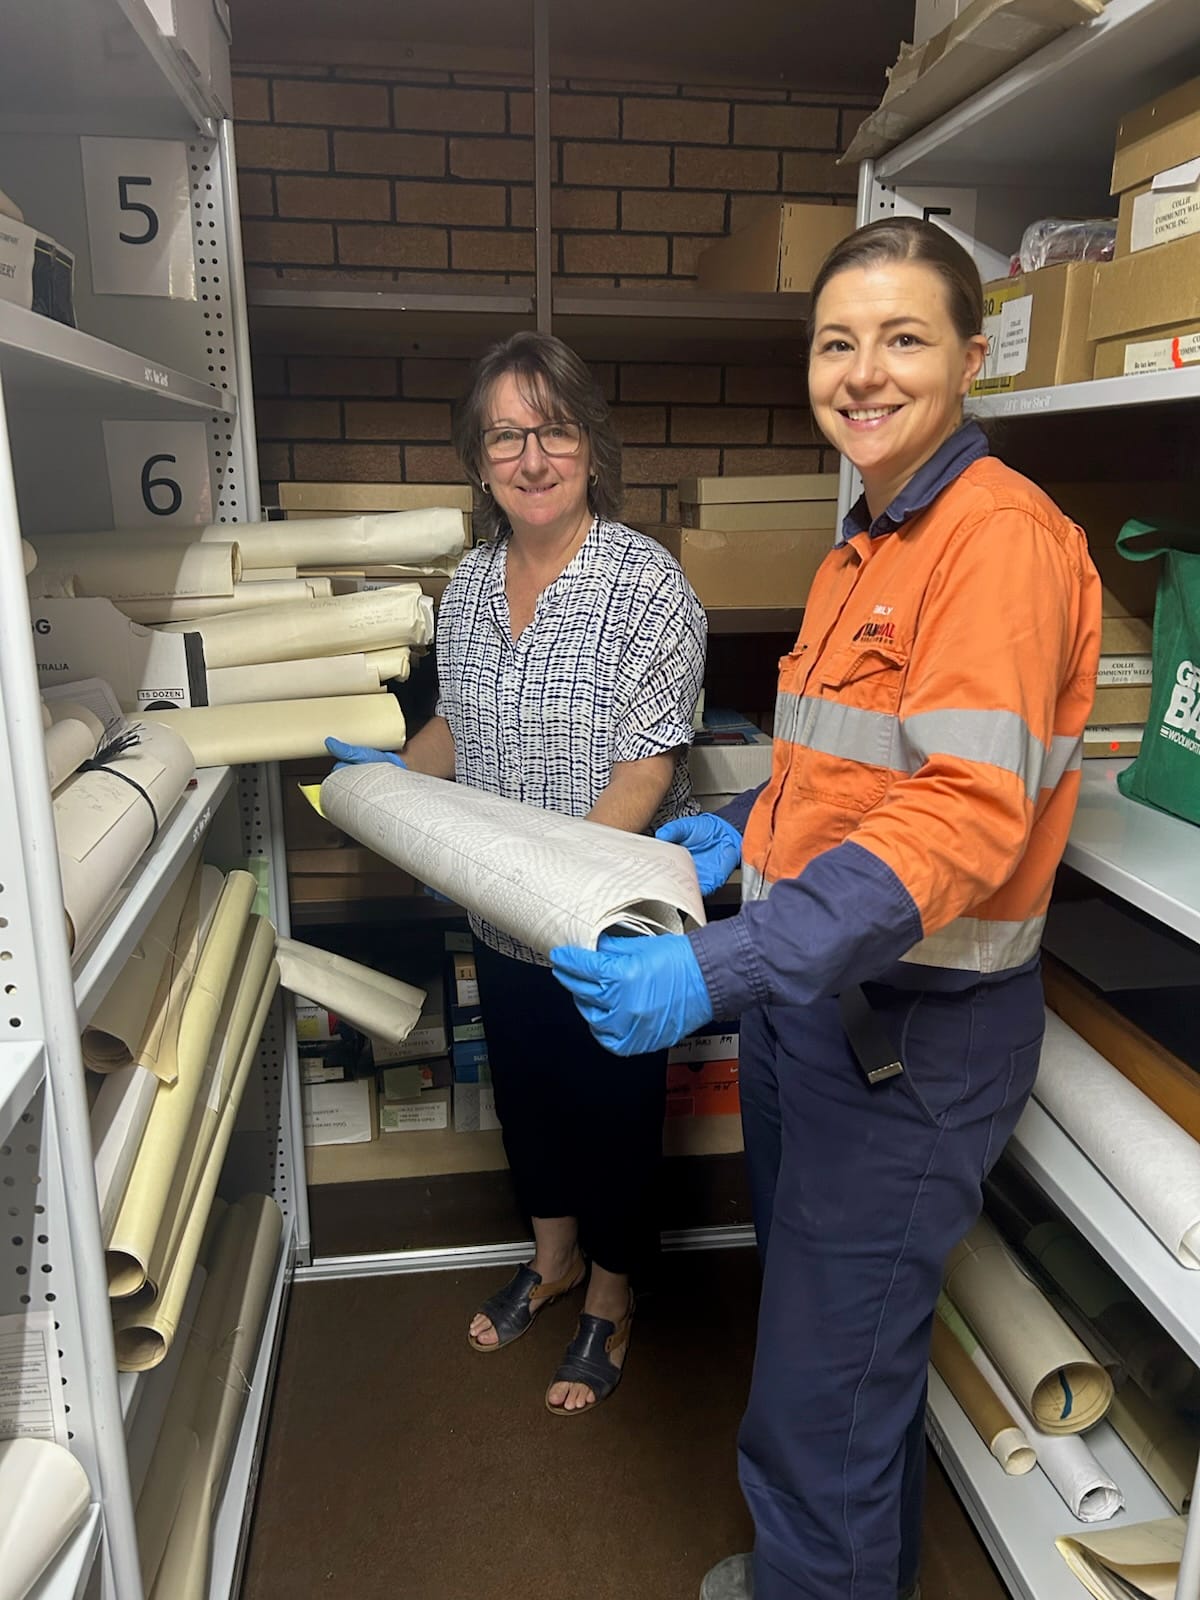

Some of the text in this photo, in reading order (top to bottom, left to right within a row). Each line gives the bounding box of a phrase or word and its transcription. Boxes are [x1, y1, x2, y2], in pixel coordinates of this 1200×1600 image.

[118, 176, 159, 245] 5
[141, 454, 182, 516] 6
[32, 618, 51, 635] G
[152, 690, 182, 698] DOZEN
